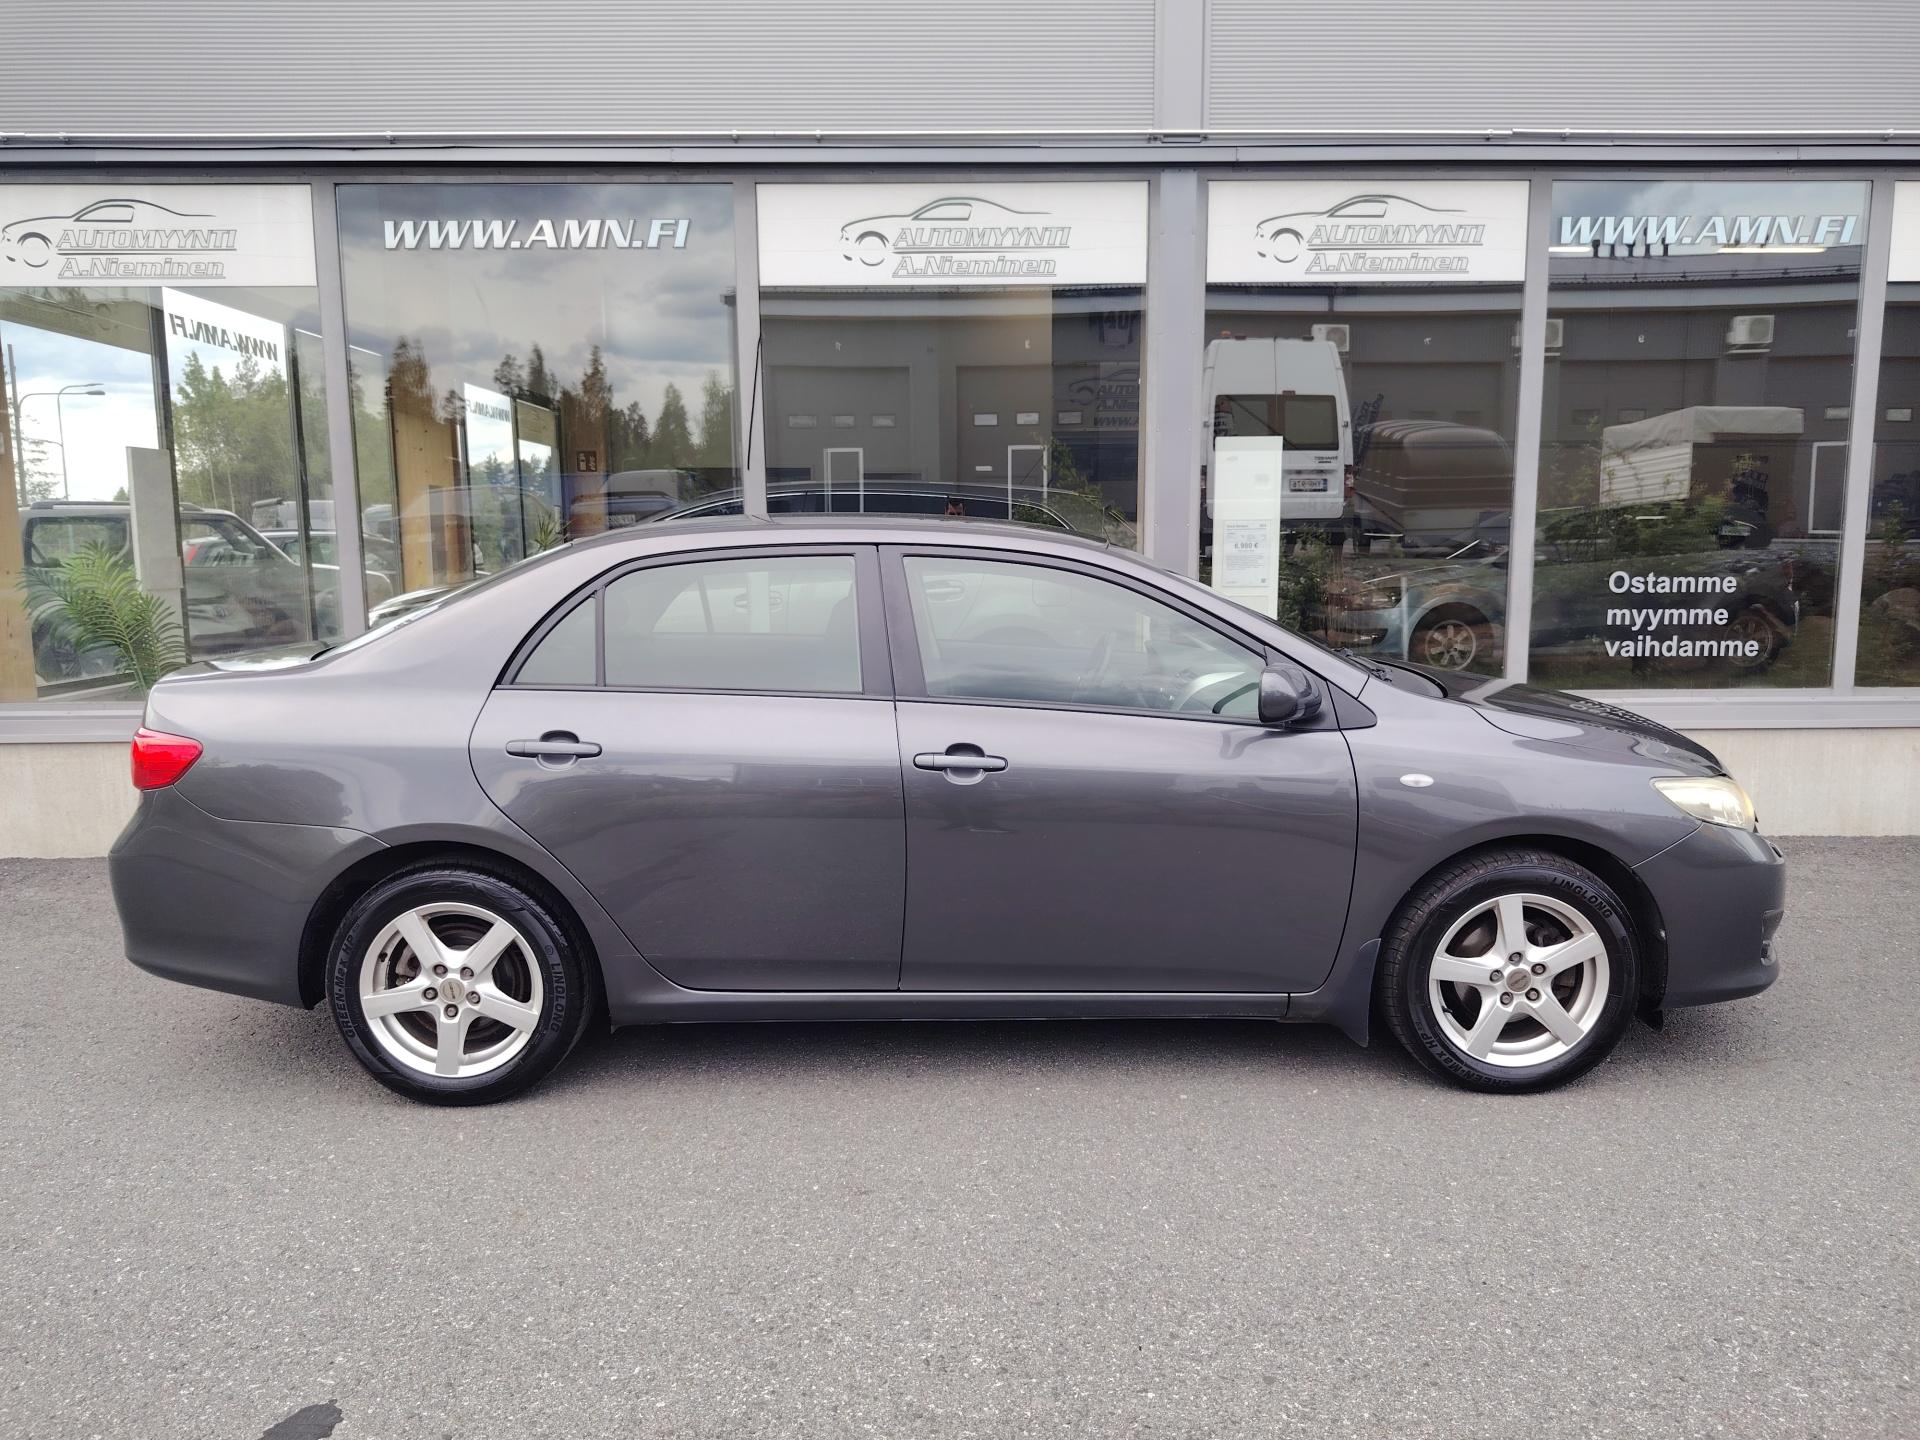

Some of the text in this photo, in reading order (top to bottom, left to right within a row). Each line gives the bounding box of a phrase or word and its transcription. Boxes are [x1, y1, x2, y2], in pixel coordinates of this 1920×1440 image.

[56, 229, 238, 249] AUTOMYYNTI
[383, 218, 690, 250] WWW.AMN.FI
[893, 226, 1072, 248] AUTOMYYNTI
[1307, 224, 1486, 245] AUTOMYYNTI
[1559, 214, 1859, 245] WWW.AMN.FI
[58, 257, 226, 278] A.Nieminen
[893, 255, 1057, 276] A.Nieminen
[1306, 252, 1469, 272] A.Nieminen
[1608, 571, 1737, 594] Ostamme
[1606, 607, 1729, 631] myymme
[1604, 635, 1759, 658] vaihdamme
[1552, 876, 1614, 919] LINGLONG
[550, 962, 566, 1033] LINGLONG
